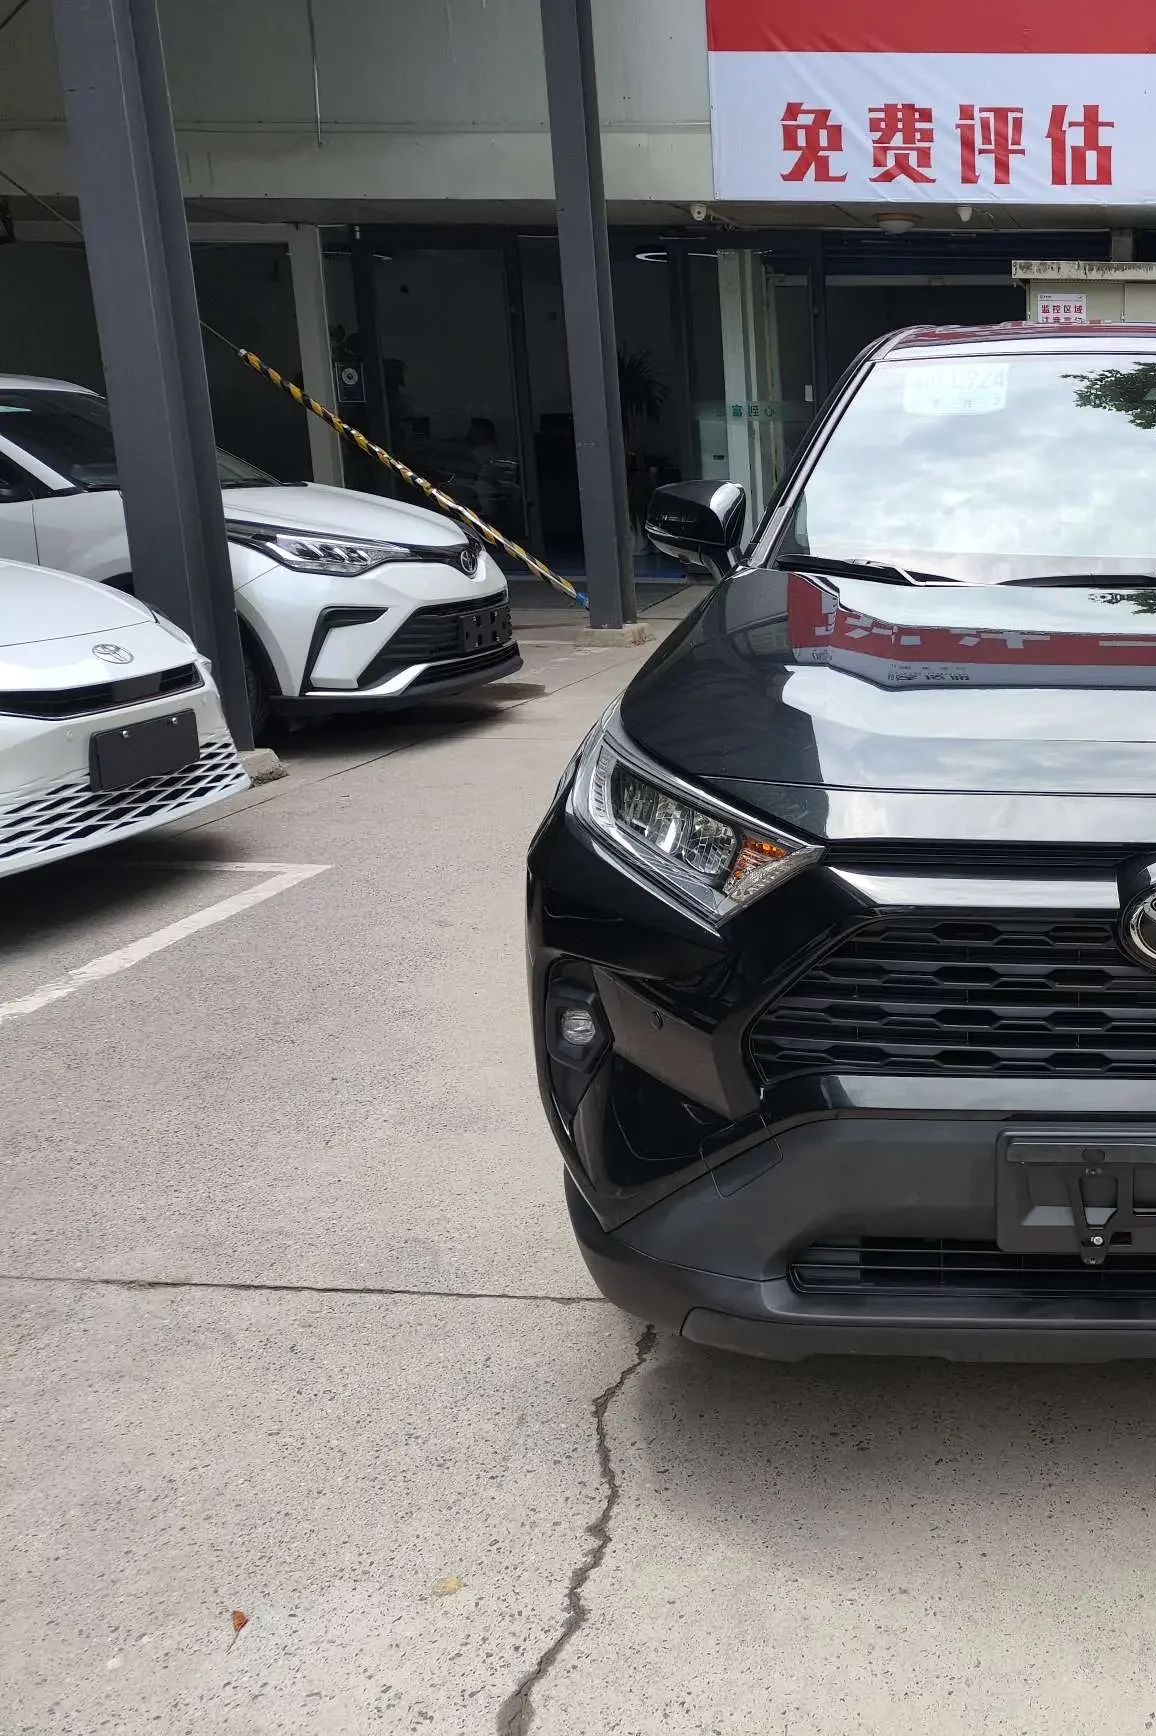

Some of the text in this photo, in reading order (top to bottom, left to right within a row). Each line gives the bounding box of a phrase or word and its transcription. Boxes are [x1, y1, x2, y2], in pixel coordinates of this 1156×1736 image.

[780, 102, 1114, 185] 免费评估
[1041, 304, 1083, 314] 监控区域
